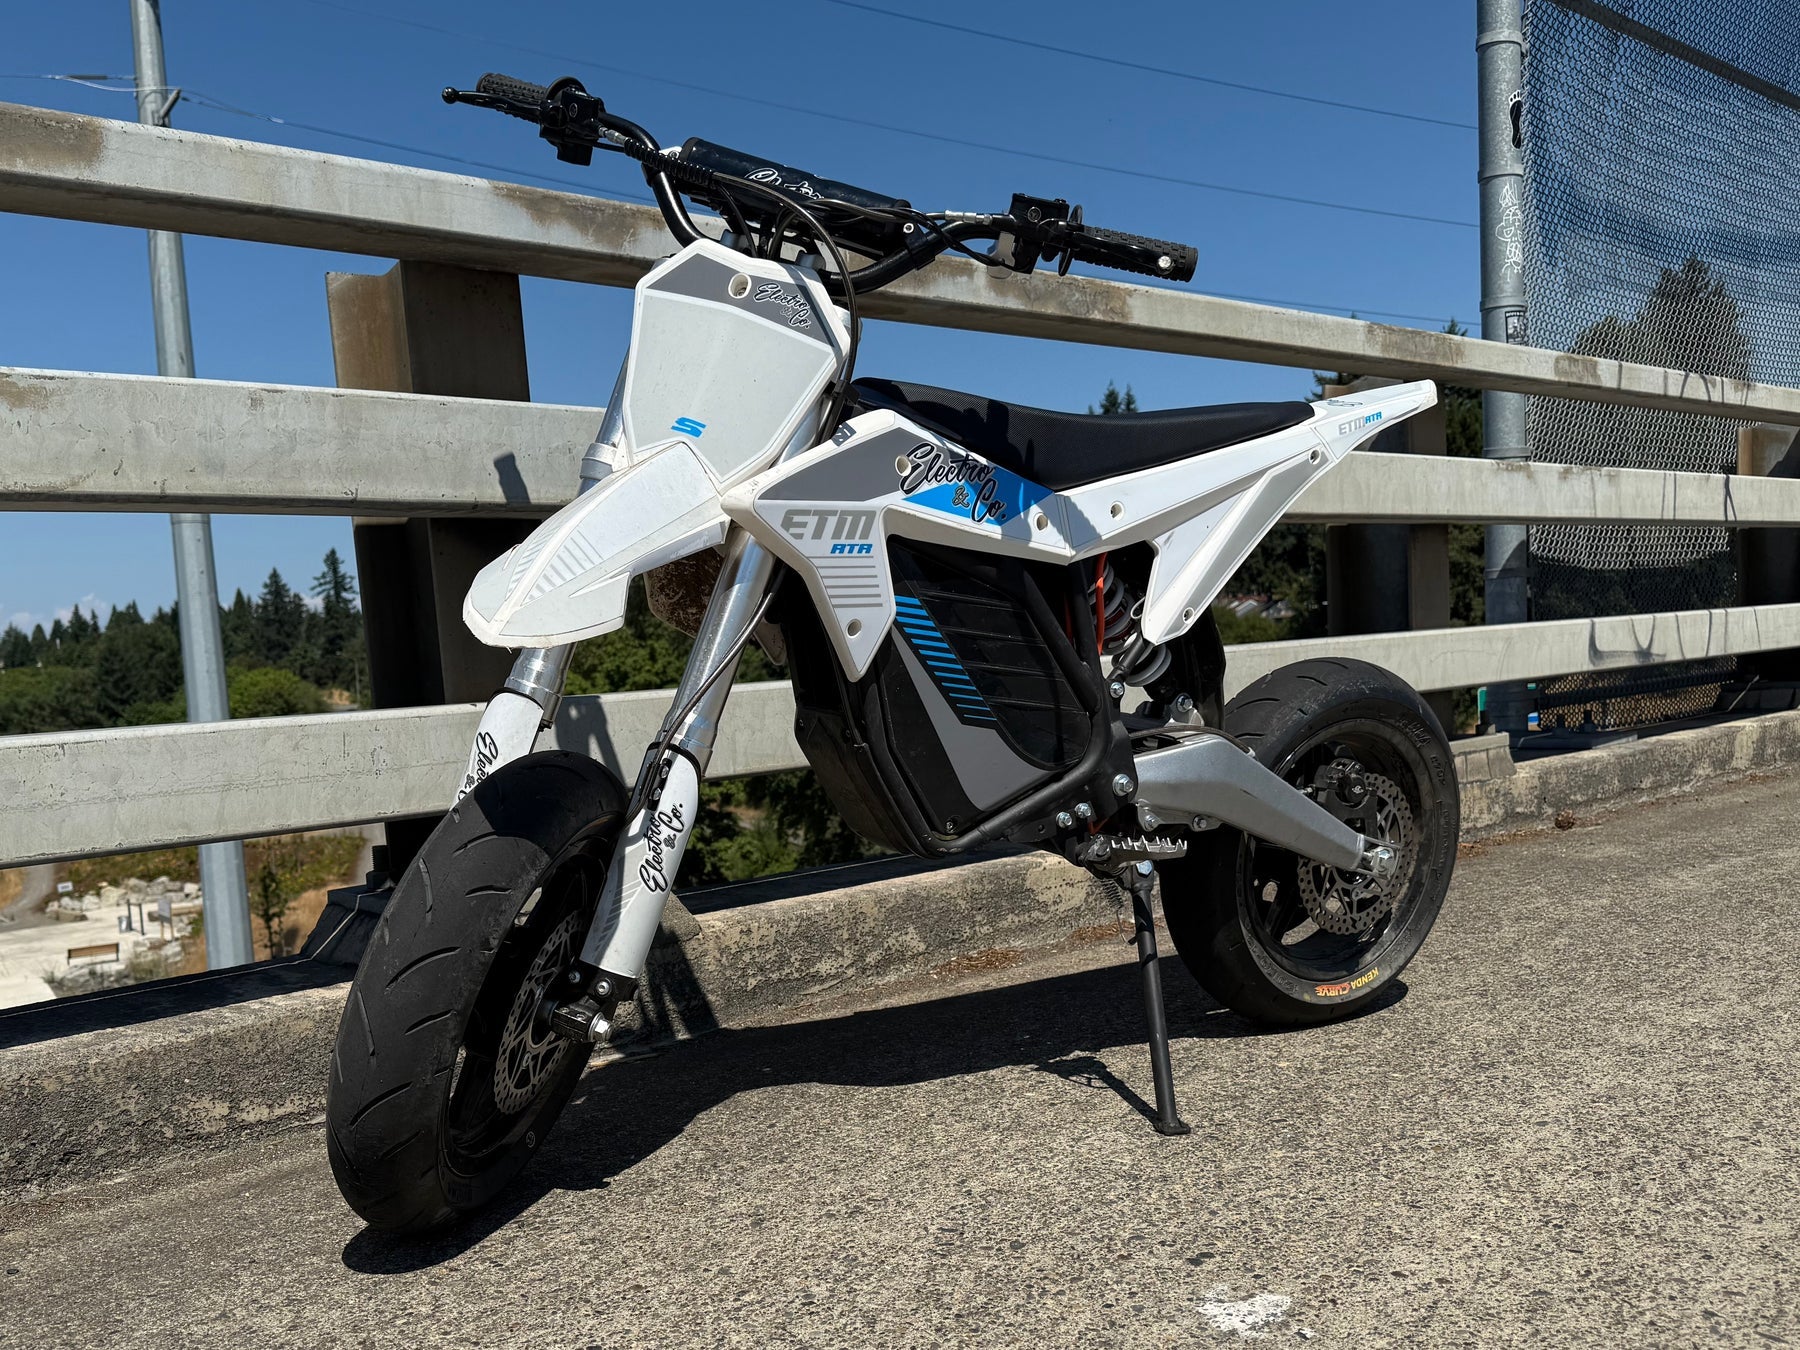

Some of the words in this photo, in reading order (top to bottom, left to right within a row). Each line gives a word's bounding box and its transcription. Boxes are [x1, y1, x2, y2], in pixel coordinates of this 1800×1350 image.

[754, 282, 809, 310] Electro
[788, 310, 810, 329] Co.
[1338, 415, 1366, 436] ETM
[900, 442, 994, 495] Electro
[952, 486, 970, 508] &
[970, 479, 1006, 523] Co.
[780, 509, 877, 540] ETM
[476, 732, 499, 783] Elec
[658, 803, 684, 834] Co.
[639, 814, 669, 893] Electro
[1314, 982, 1351, 996] CURVE
[1350, 967, 1379, 989] KENDA
